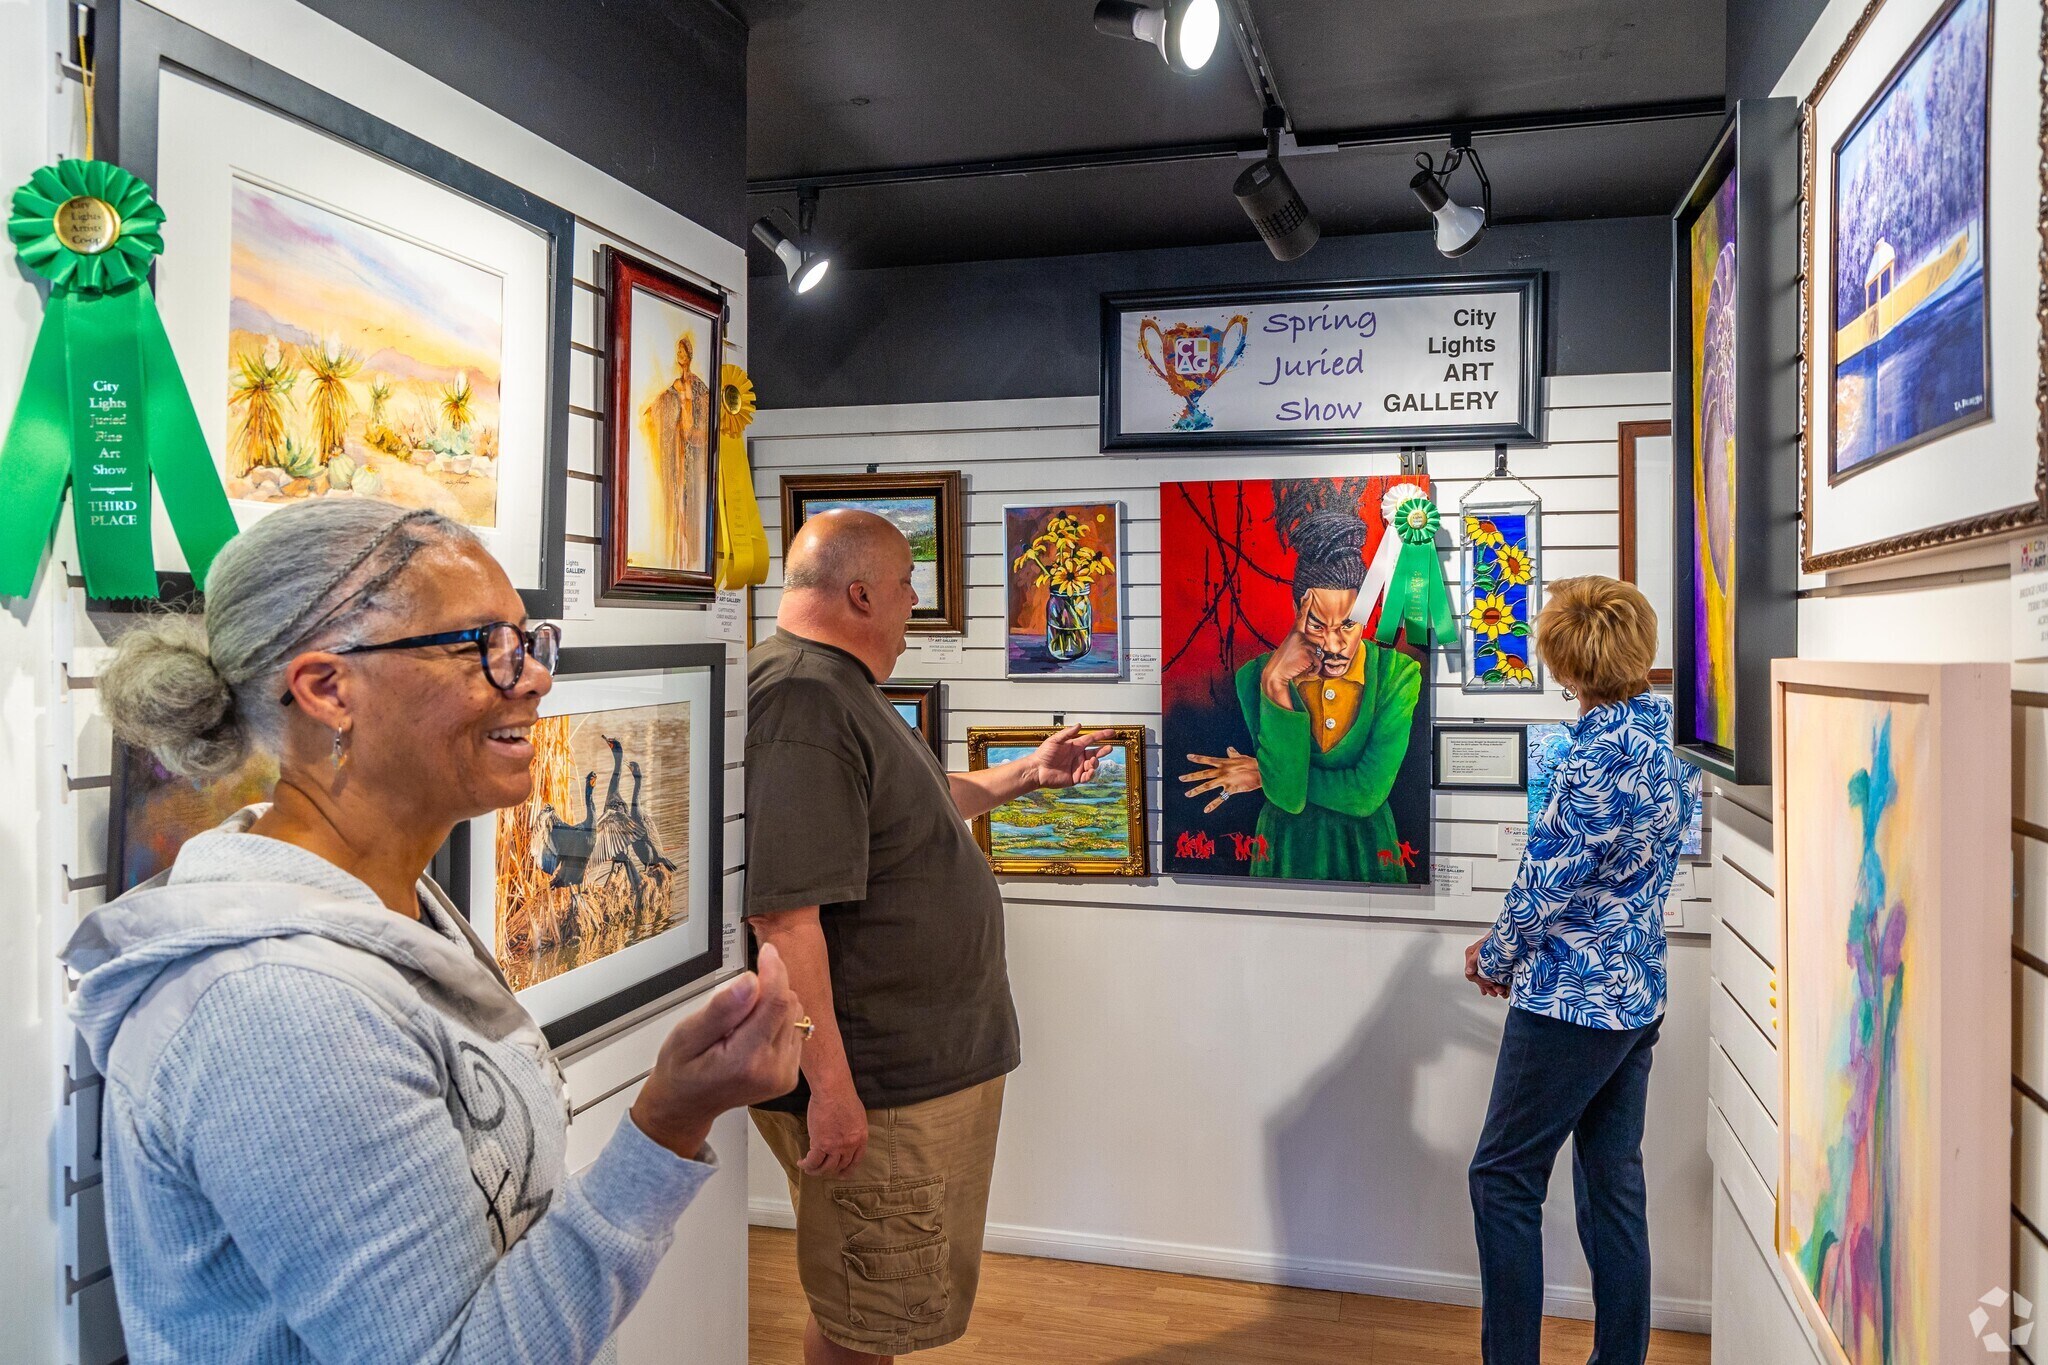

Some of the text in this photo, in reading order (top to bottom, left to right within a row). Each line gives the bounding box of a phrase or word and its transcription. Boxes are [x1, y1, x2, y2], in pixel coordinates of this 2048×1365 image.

[71, 212, 101, 223] Lights
[71, 224, 101, 232] Artists
[1263, 304, 1376, 343] Spring
[1453, 309, 1496, 330] City
[1428, 336, 1496, 358] Lights
[1259, 348, 1364, 385] Juried
[1443, 362, 1494, 382] ART
[93, 380, 120, 394] City
[89, 397, 127, 411] Lights
[1276, 397, 1362, 421] Show
[1383, 391, 1499, 413] GALLERY
[89, 414, 127, 428] Juried
[95, 431, 123, 442] Fine
[98, 448, 121, 459] Art
[92, 464, 127, 475] Show
[88, 500, 137, 511] THIRD
[90, 514, 137, 525] PLACE
[2034, 555, 2047, 568] ART
